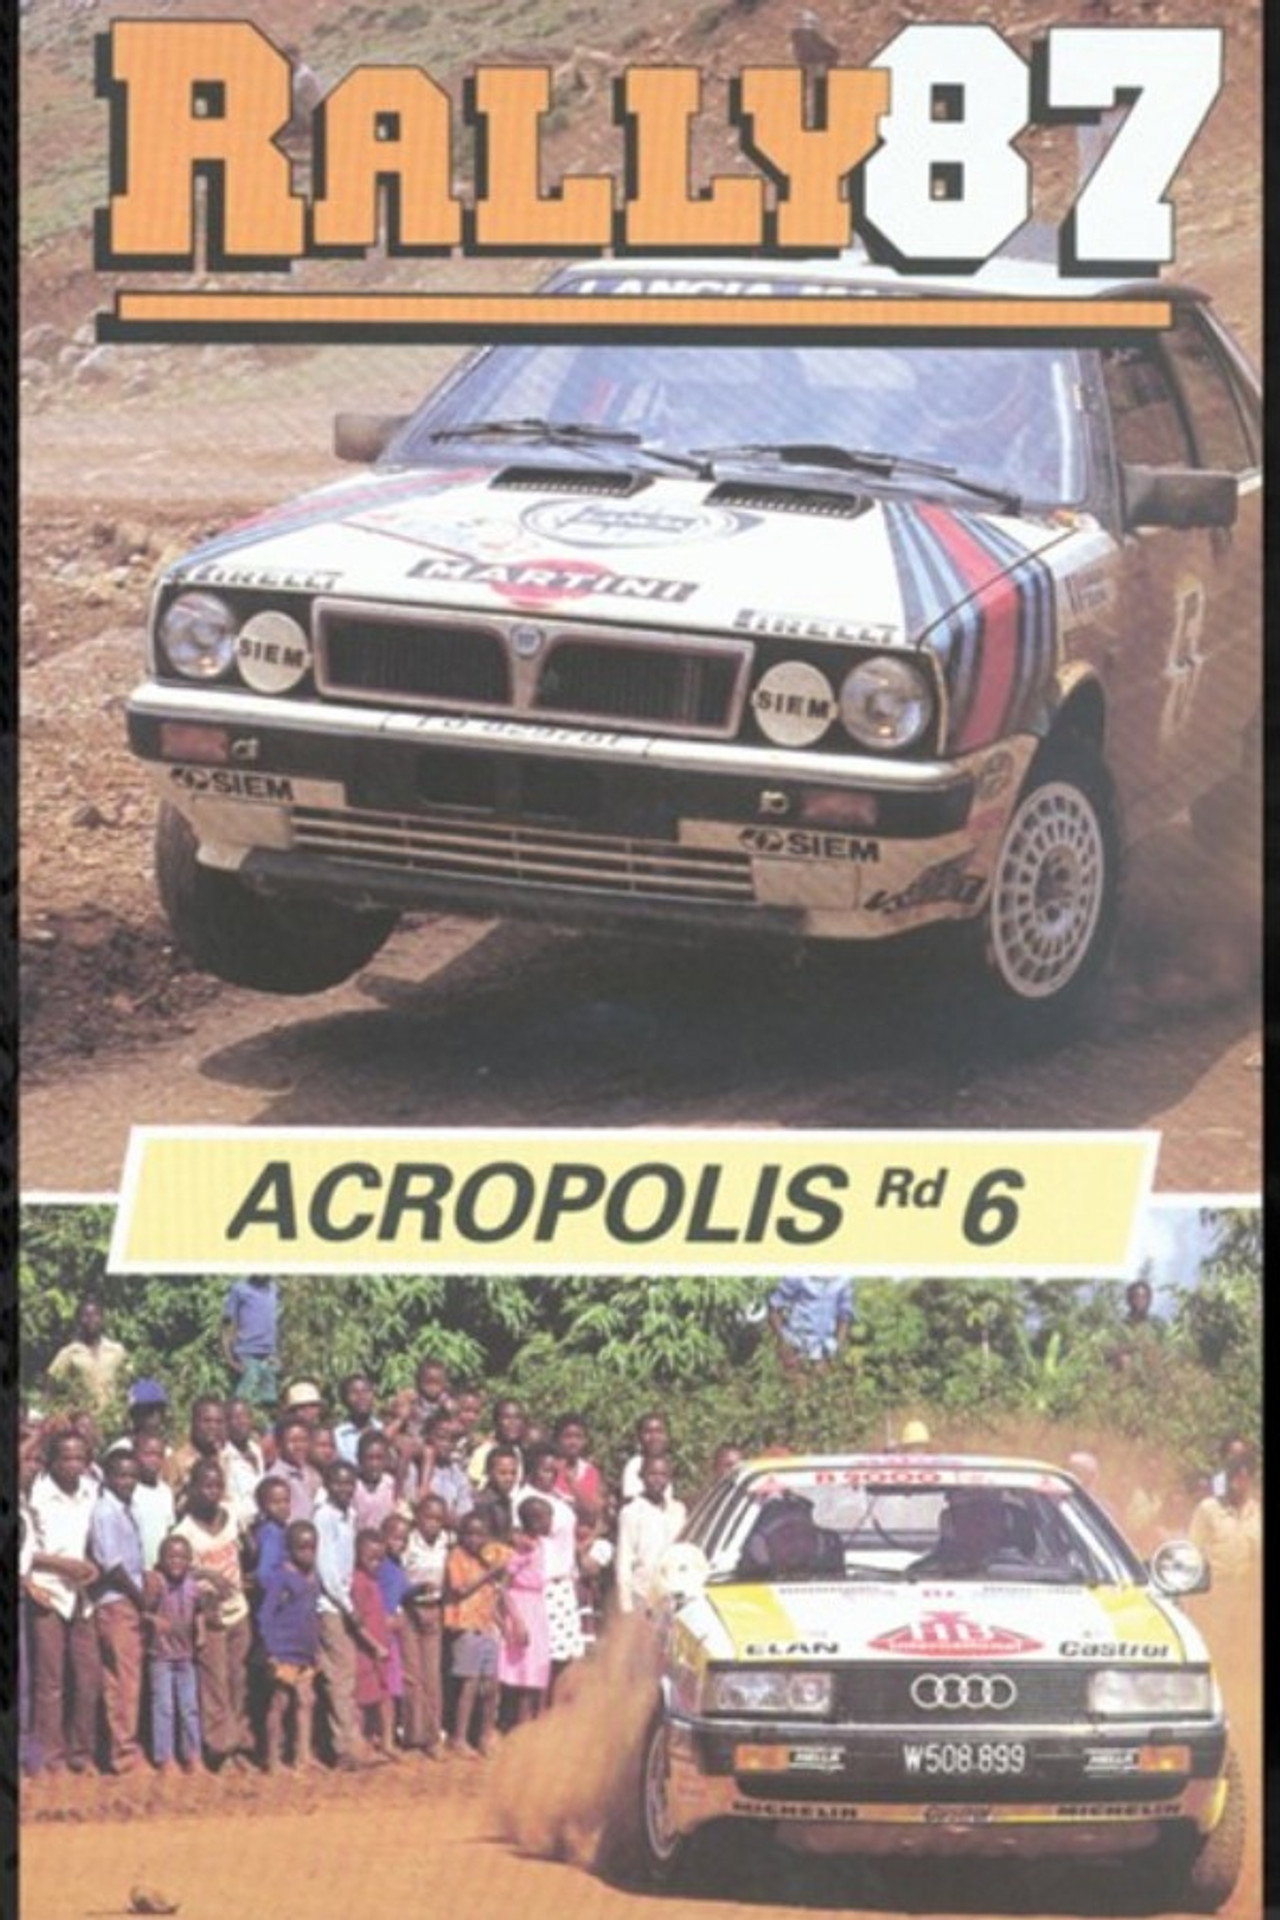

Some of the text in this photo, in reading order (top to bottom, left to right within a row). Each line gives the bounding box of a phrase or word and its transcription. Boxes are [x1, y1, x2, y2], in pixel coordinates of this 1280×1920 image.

[410, 557, 692, 601] MARTINI
[239, 638, 304, 668] SIEM
[757, 689, 829, 718] SIEM
[212, 770, 294, 802] SIEM
[788, 832, 880, 863] SIEM
[228, 1163, 1023, 1244] ACROPOLIS Rd 6
[1059, 1640, 1169, 1657] Castrol
[732, 1801, 858, 1819] MICHELIN
